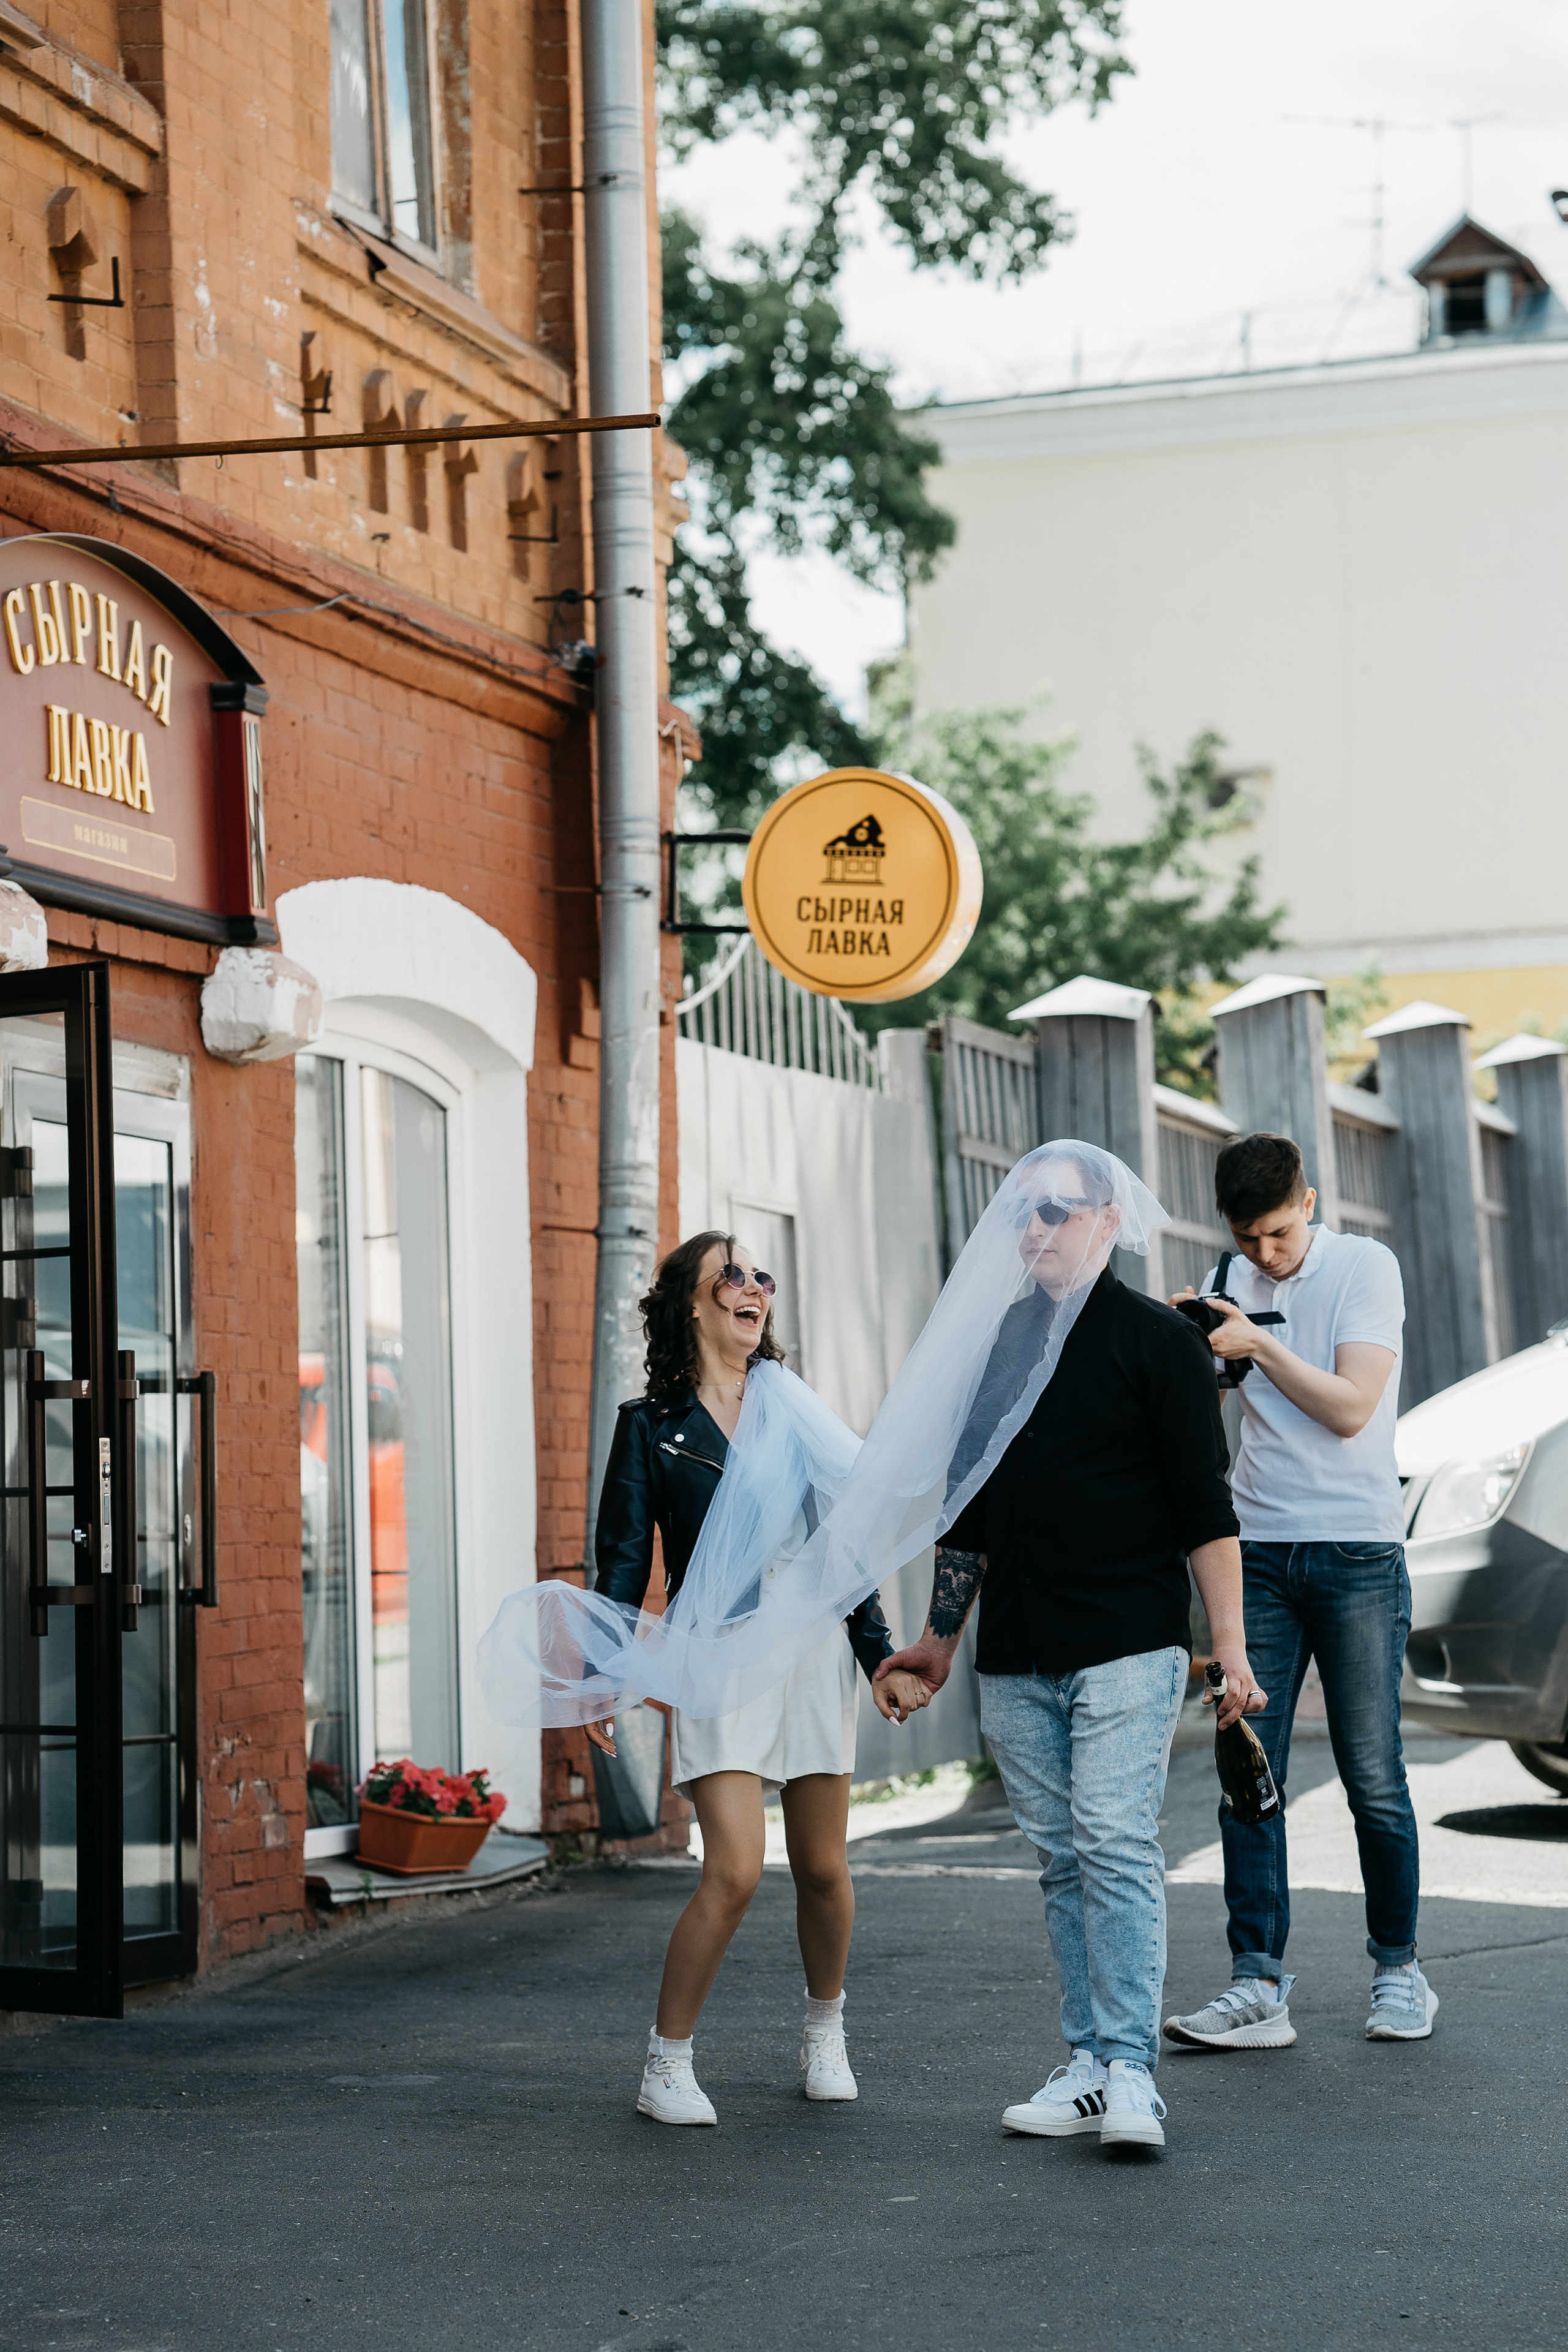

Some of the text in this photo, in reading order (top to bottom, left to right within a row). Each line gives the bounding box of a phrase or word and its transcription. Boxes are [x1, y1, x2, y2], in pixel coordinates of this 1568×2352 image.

[4, 579, 174, 727] СЫРНАЯ
[46, 703, 156, 814] ЛАВКА
[797, 897, 903, 924] СЫРНАЯ
[808, 929, 890, 956] ЛАВКА
